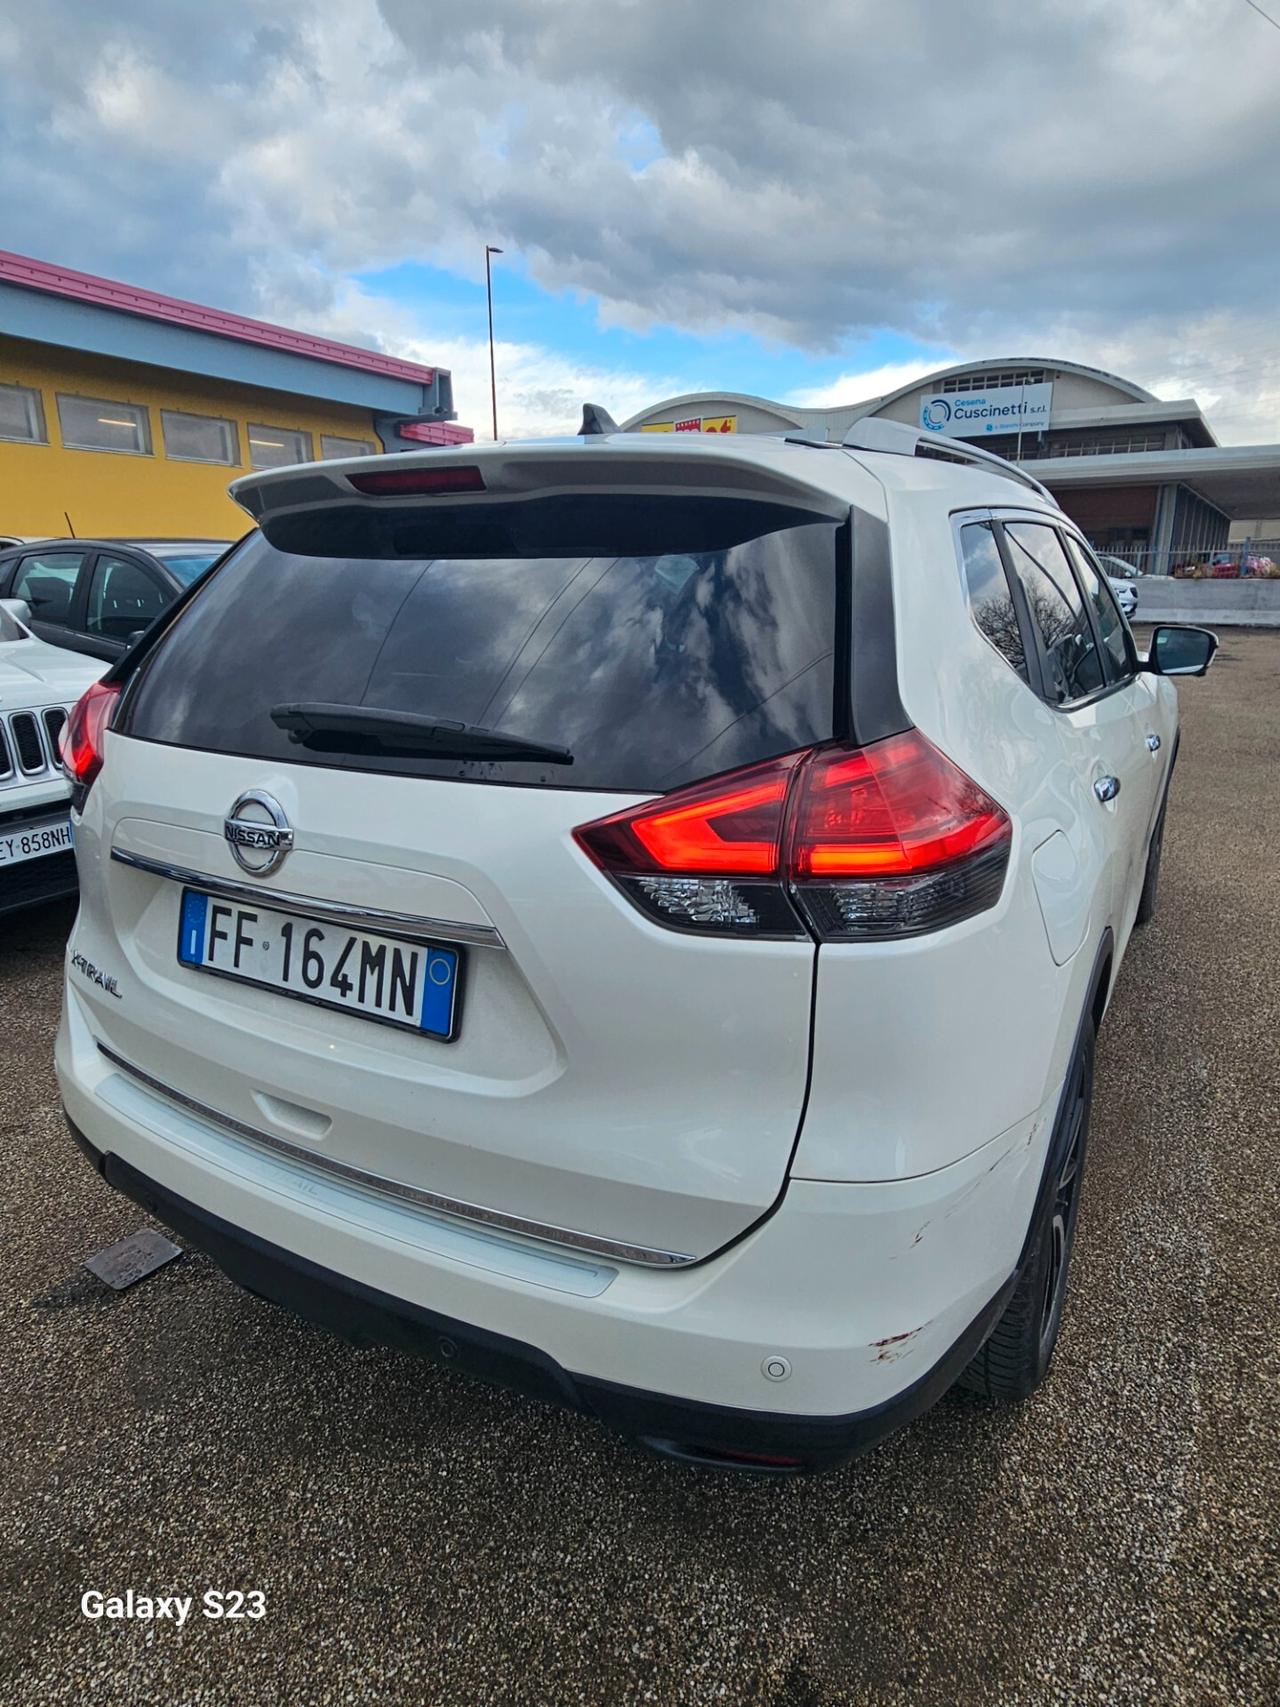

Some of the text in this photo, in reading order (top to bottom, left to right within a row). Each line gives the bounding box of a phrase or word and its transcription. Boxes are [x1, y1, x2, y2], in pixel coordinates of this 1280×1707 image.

[954, 399, 986, 407] Cesena
[954, 402, 1028, 419] Cuscinetti
[20, 826, 71, 854] 858NH
[225, 825, 280, 846] NISSAN
[208, 904, 419, 1017] FF 164MN
